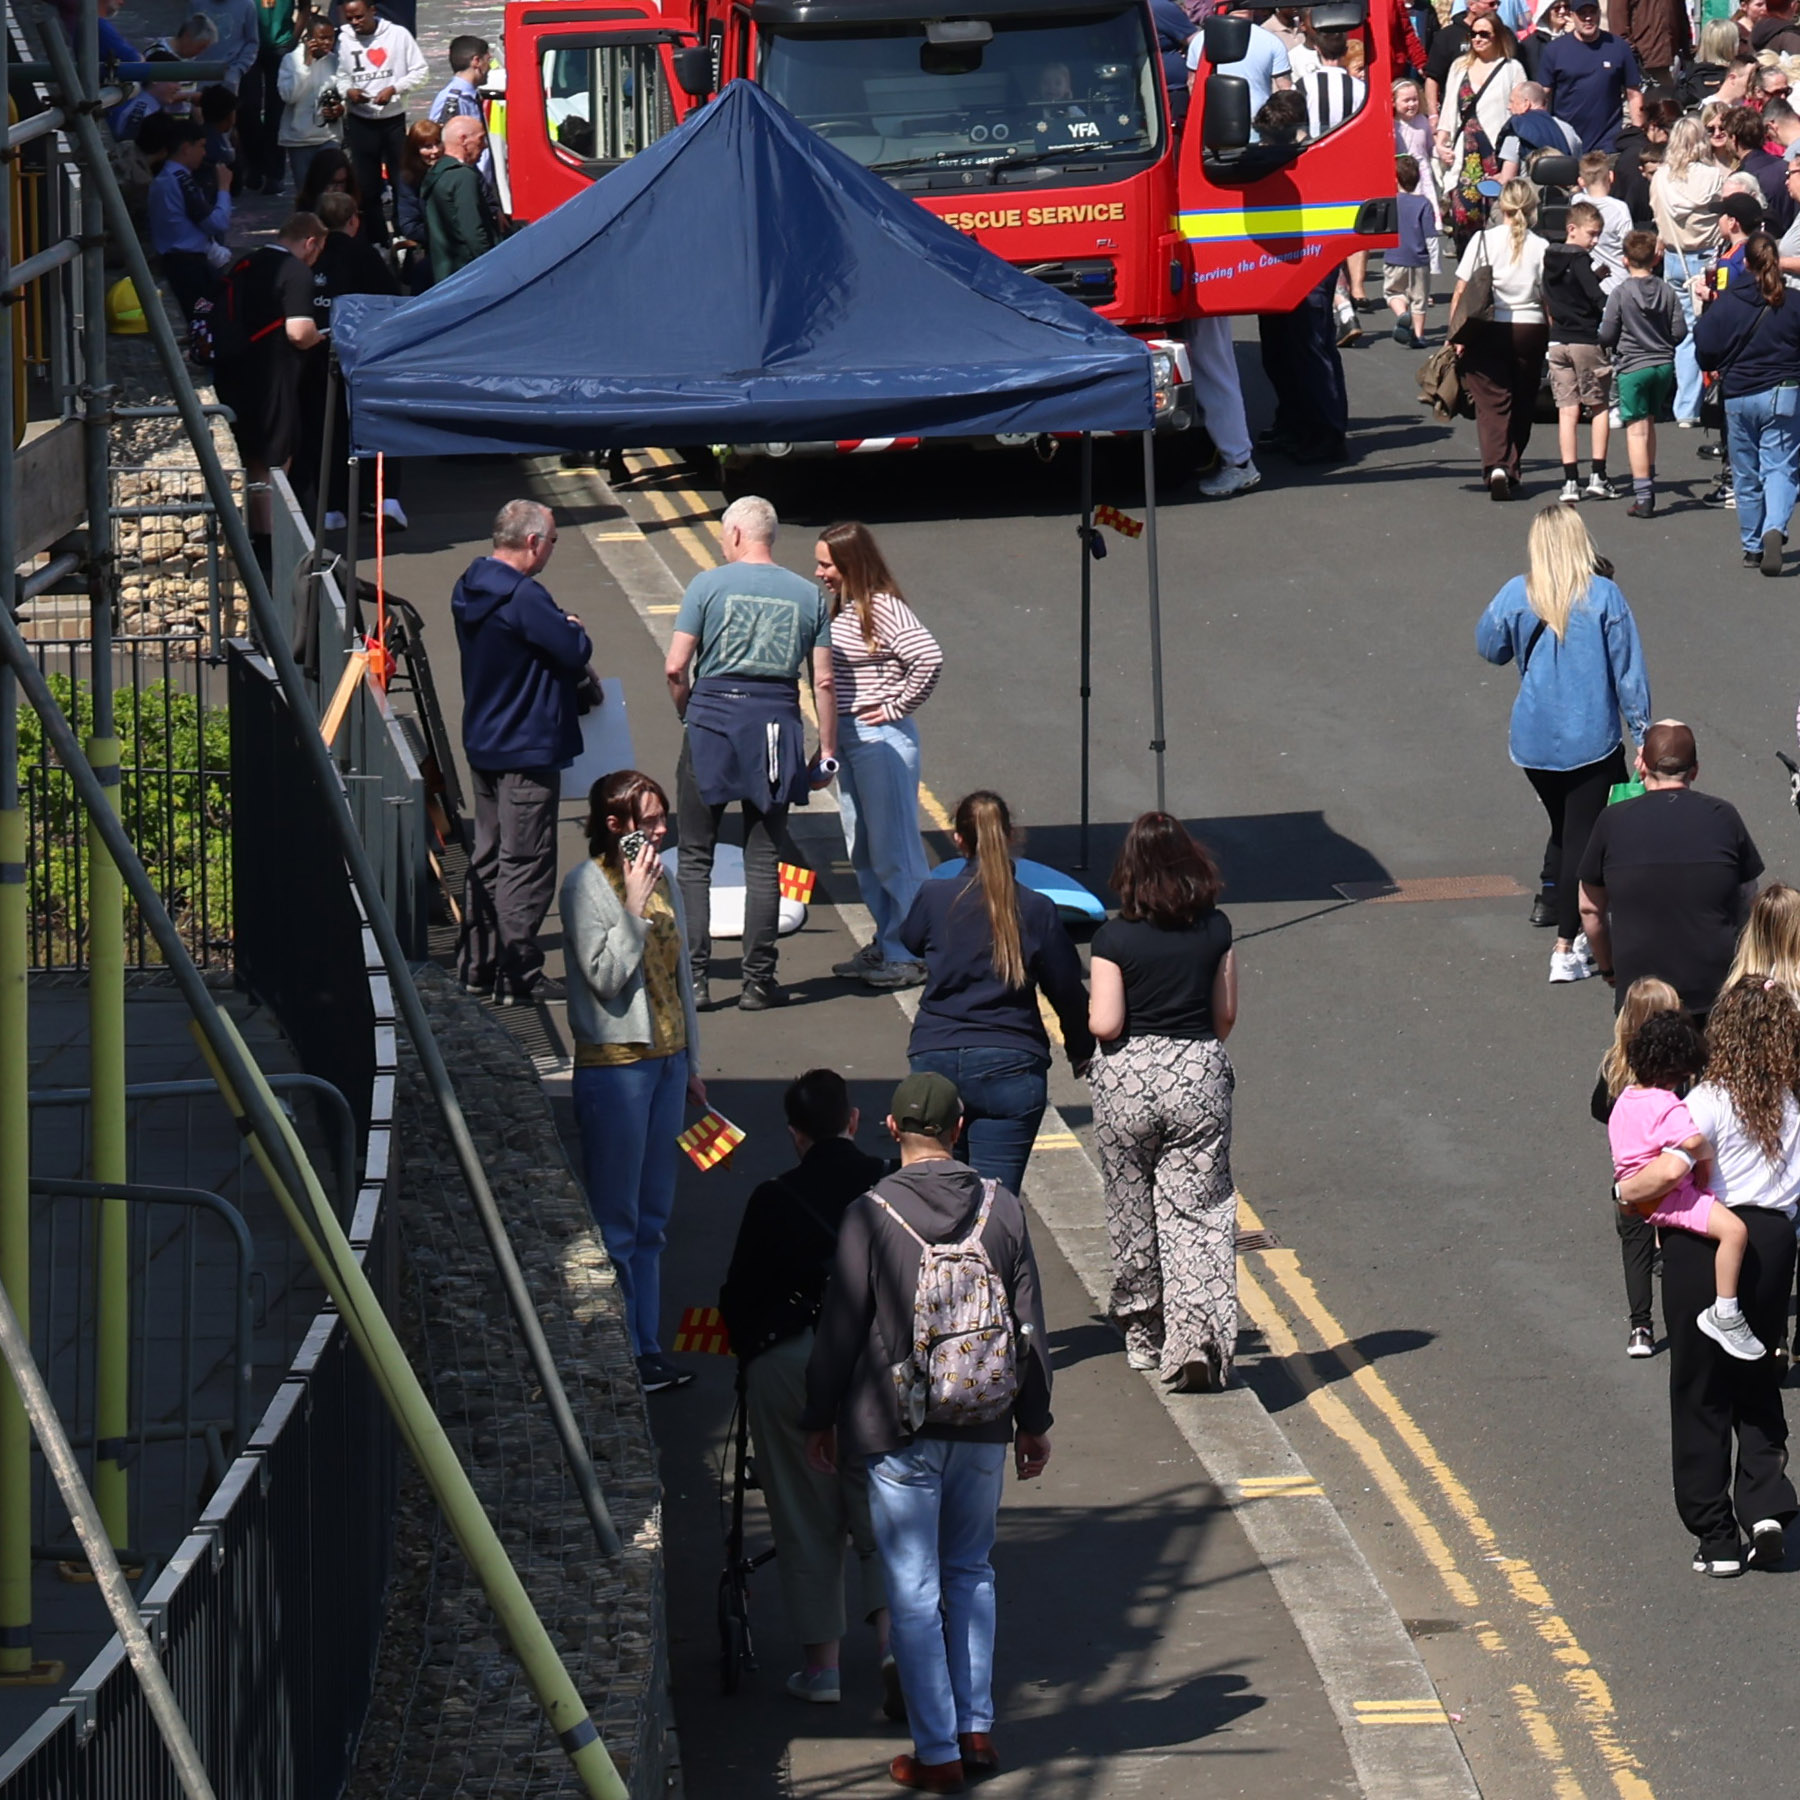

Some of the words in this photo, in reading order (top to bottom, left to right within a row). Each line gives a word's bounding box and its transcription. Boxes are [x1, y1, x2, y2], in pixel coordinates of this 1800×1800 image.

[351, 50, 365, 72] I
[1068, 122, 1100, 138] YFA
[1027, 202, 1124, 226] SERVICE
[1096, 238, 1117, 248] FL
[1192, 267, 1234, 284] Serving
[1238, 260, 1255, 274] the
[1259, 244, 1322, 268] Community
